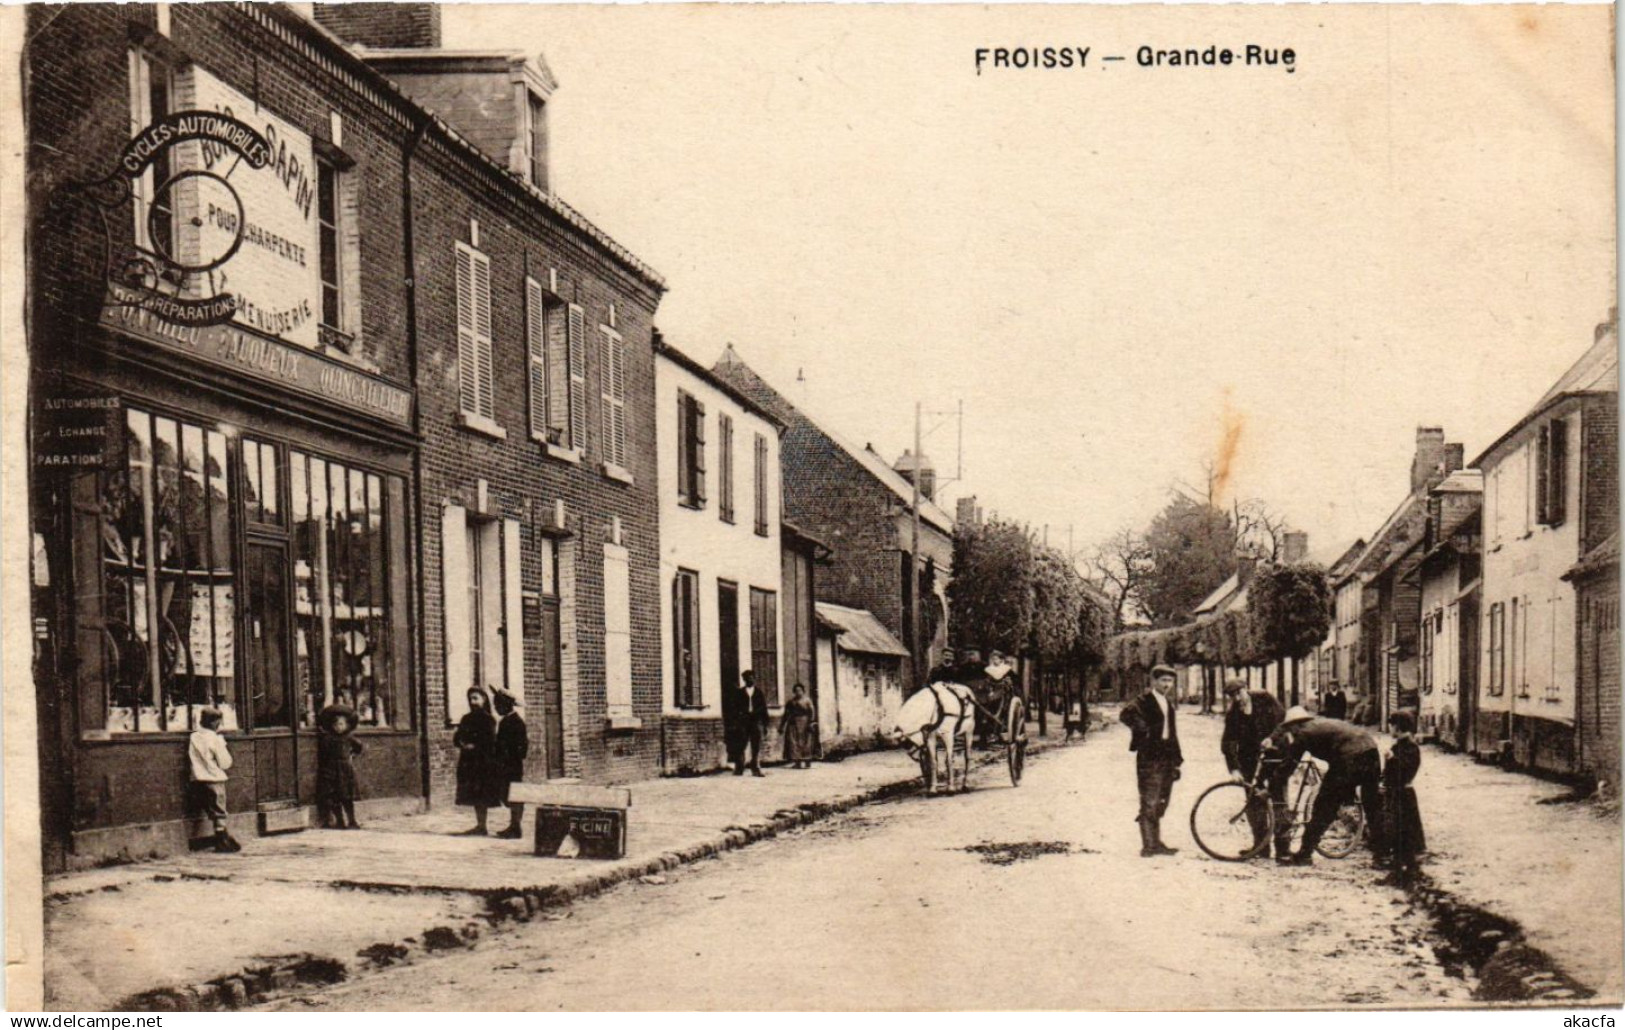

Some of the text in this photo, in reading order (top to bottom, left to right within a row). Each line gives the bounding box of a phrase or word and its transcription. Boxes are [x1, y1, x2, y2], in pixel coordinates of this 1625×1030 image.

[265, 123, 314, 221] SAPIN
[208, 203, 238, 236] POUR
[45, 396, 120, 410] AUTOMOBILES
